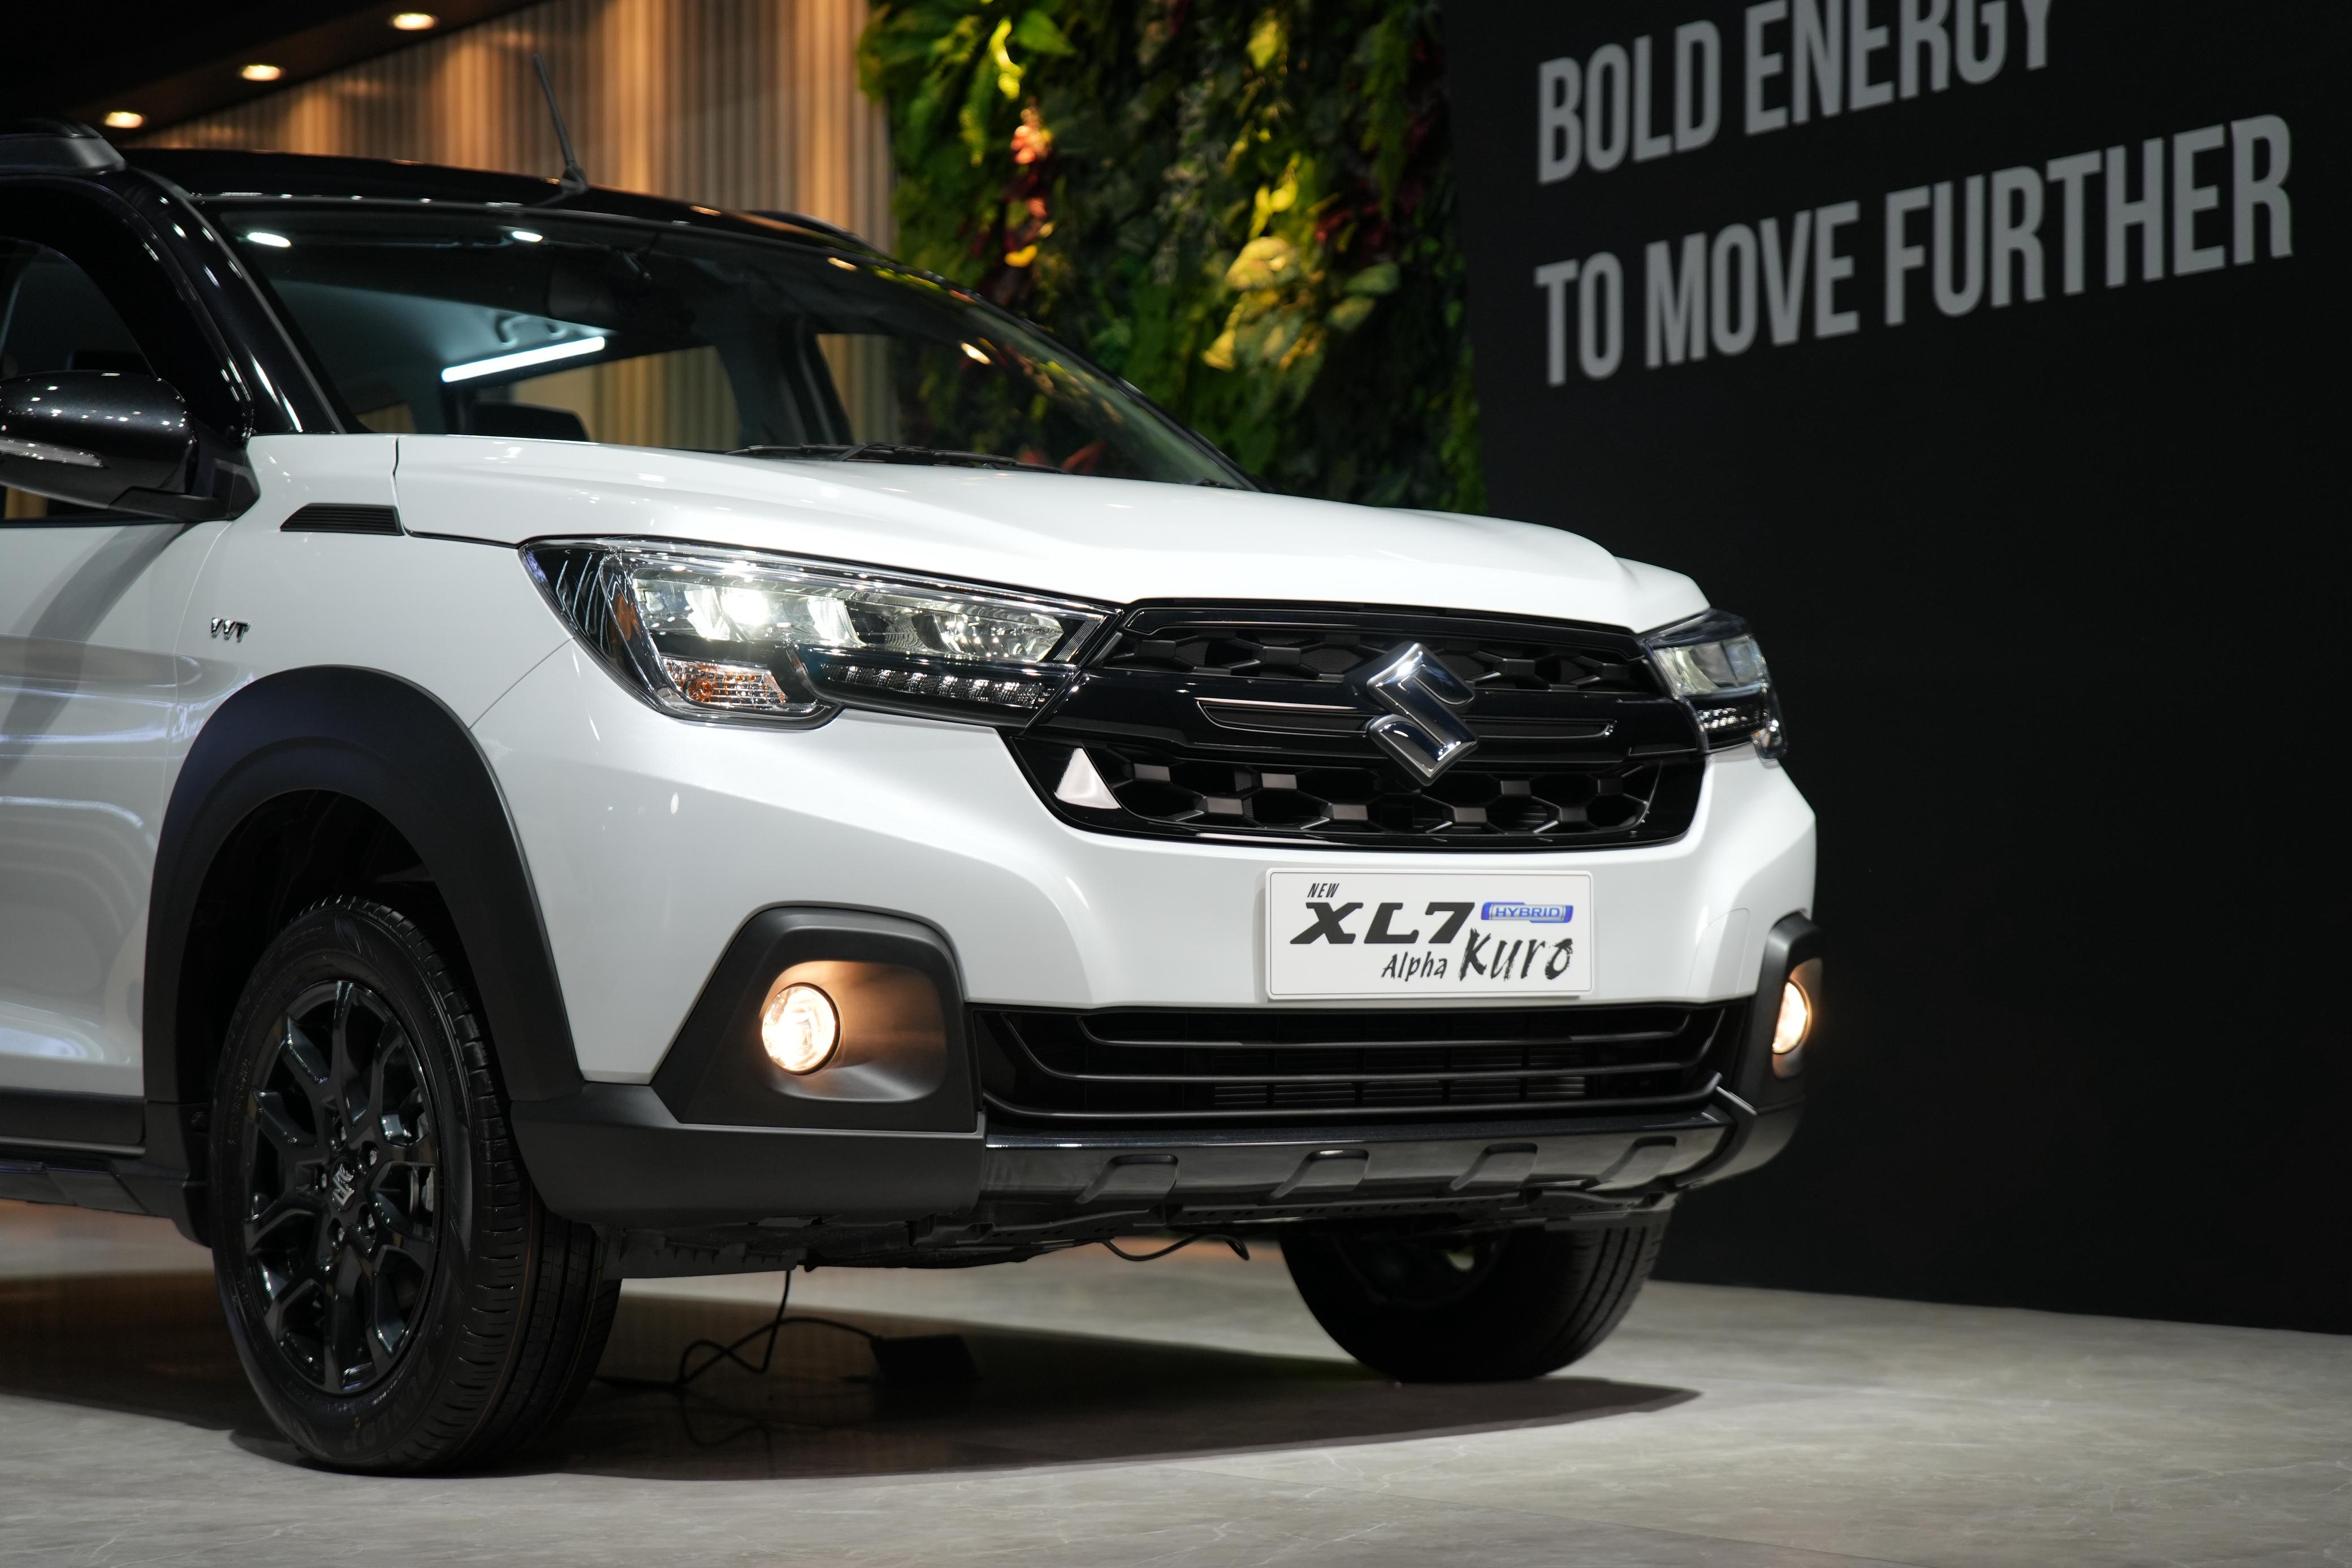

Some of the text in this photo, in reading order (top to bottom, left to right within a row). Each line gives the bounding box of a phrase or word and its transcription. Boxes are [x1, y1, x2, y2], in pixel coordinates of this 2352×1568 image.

[1538, 21, 1720, 184] BOLD
[1535, 115, 2293, 385] TO MOVE FURTHER
[211, 617, 250, 643] VVT
[1307, 883, 1340, 898] NEW
[1290, 902, 1476, 945] XL7
[1494, 906, 1561, 919] HYBRID
[1381, 951, 1448, 982] Alpha
[1459, 928, 1574, 981] Kuro
